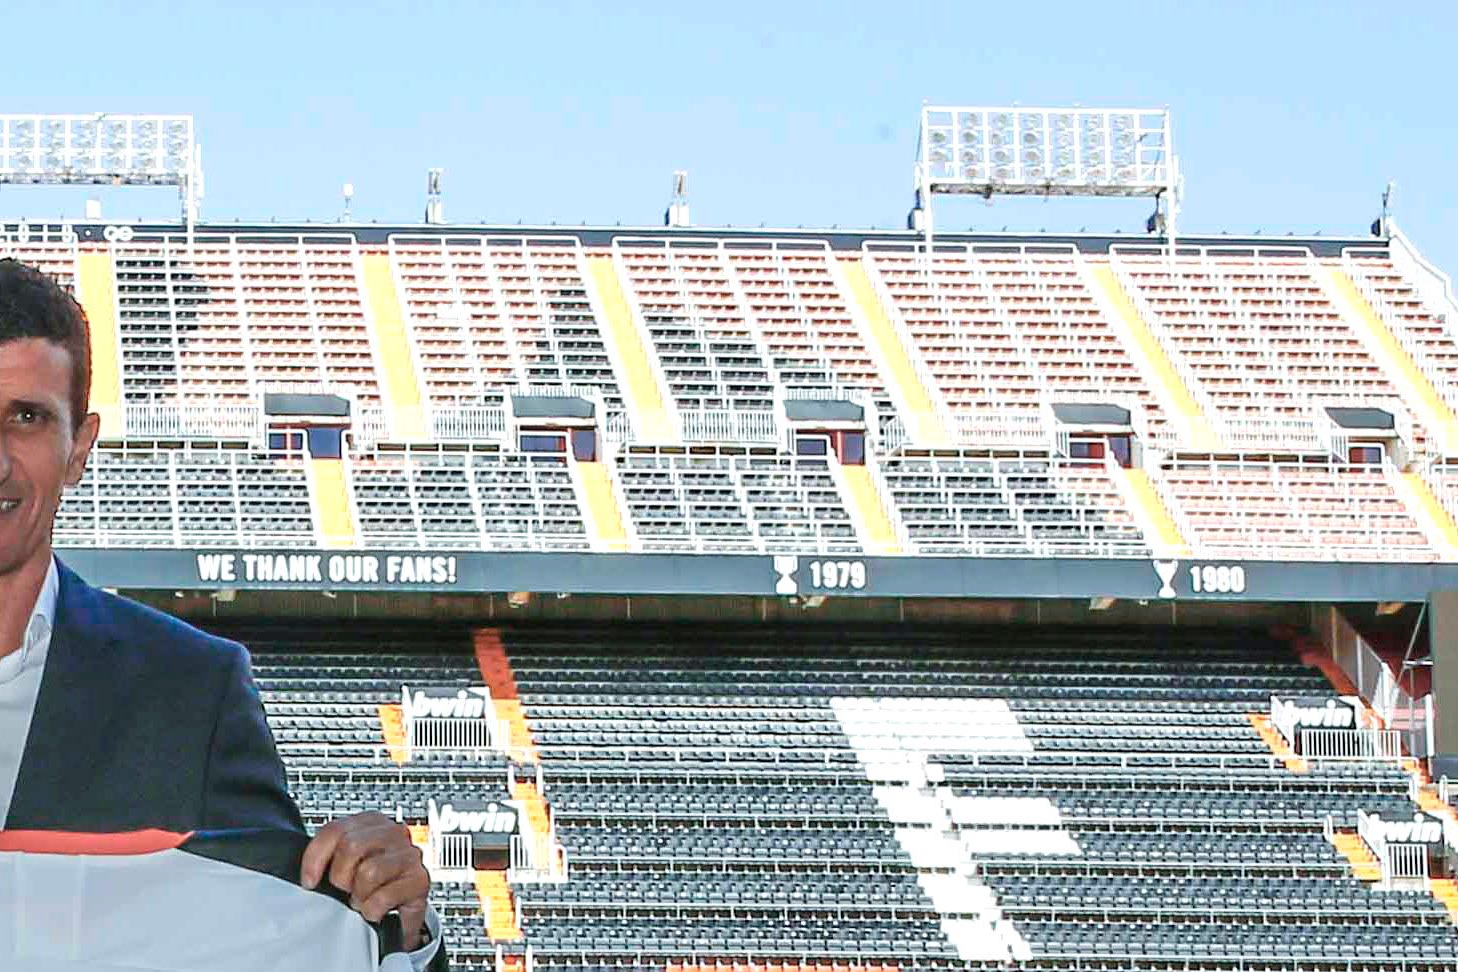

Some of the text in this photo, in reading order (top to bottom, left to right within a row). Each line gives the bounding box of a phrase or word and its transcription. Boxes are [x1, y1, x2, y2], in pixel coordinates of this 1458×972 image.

[197, 554, 457, 584] WE THANK OUR FANS!
[810, 560, 866, 589] 1979
[1190, 565, 1245, 592] 1980
[413, 690, 483, 717] bwin
[442, 803, 516, 832] bwin
